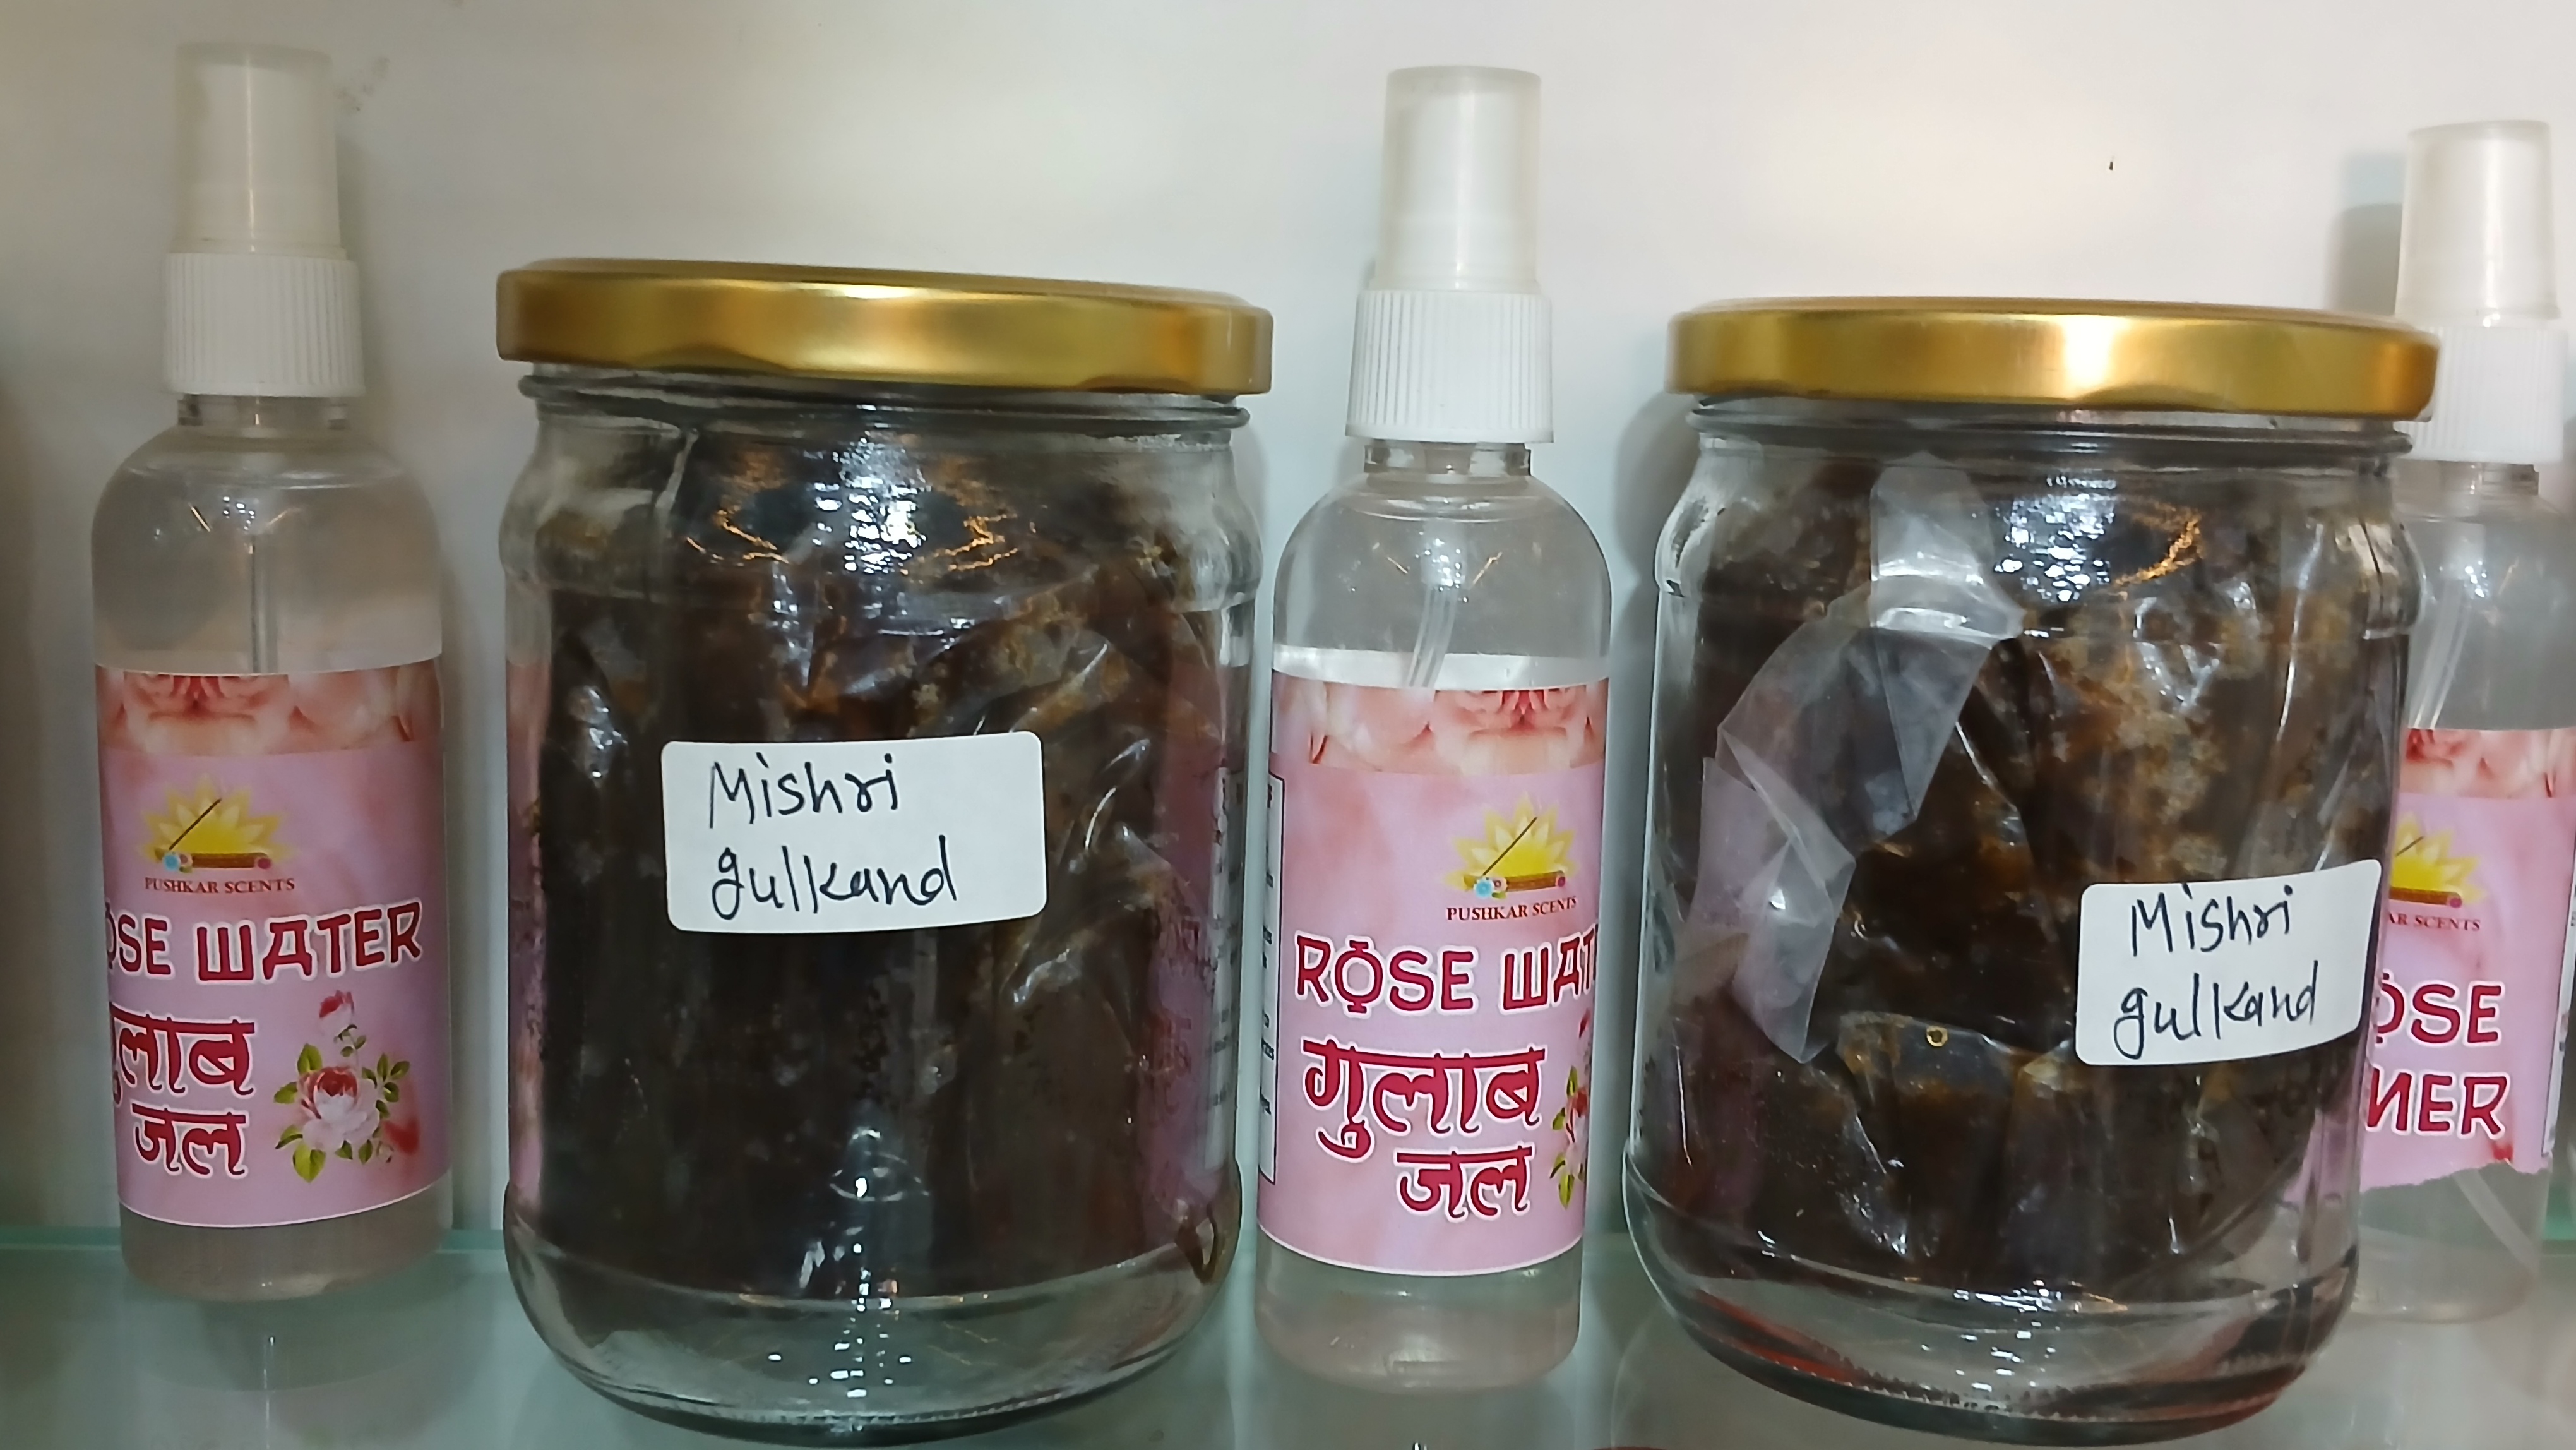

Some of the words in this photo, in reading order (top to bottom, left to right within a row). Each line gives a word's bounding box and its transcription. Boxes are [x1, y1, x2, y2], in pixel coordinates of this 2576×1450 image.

[709, 752, 898, 829] Mishri
[145, 877, 219, 894] PUSHKAR
[224, 877, 295, 894] SCENTS
[712, 834, 957, 920] gulkand
[1446, 904, 1528, 921] PUSHKAR
[1532, 895, 1577, 916] SCENTS
[196, 901, 422, 981] WATER
[2131, 882, 2293, 957] Mishri
[2414, 914, 2481, 932] SCENTS
[1296, 934, 1475, 1014] ROSE
[1503, 923, 1599, 1010] WAT
[2113, 959, 2318, 1060] gulkand
[1303, 1038, 1546, 1159] गुलाब
[2367, 1067, 2508, 1135] NER
[131, 1102, 246, 1175] जल
[1397, 1145, 1532, 1219] जल
